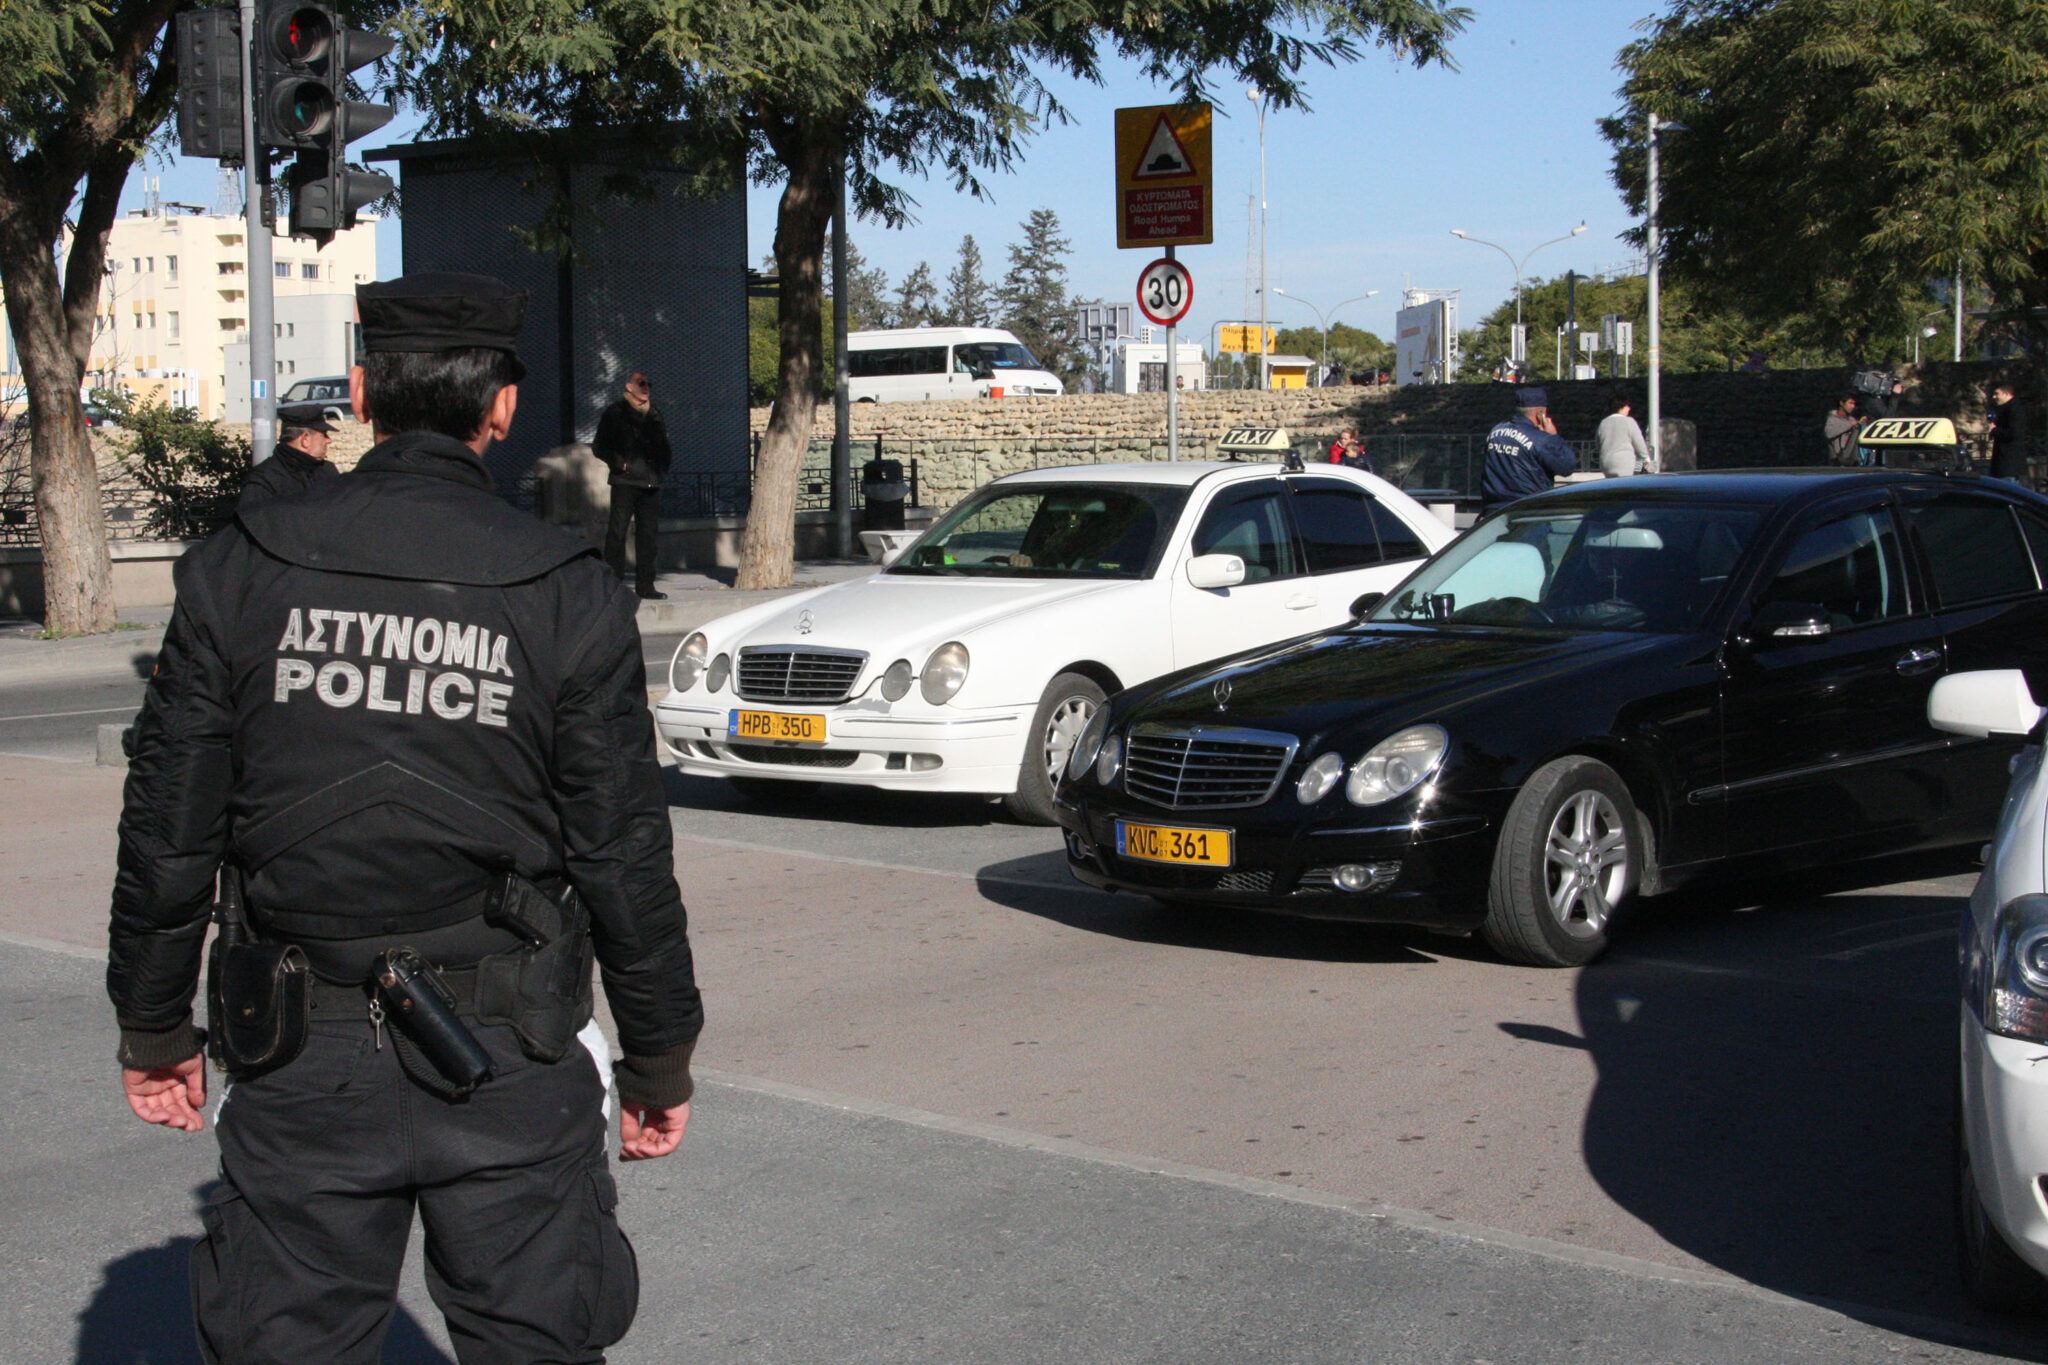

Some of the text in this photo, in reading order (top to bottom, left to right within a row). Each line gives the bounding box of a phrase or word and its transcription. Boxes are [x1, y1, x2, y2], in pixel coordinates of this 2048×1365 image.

[1134, 215, 1192, 225] Road Humps
[1148, 225, 1177, 235] Ahead
[1148, 274, 1182, 310] 30
[1226, 430, 1274, 444] TAXI
[1870, 421, 1934, 438] TAXI
[277, 608, 514, 677] ΑΣΤΥΝΟΜΙΑ
[273, 658, 514, 727] POLICE
[742, 714, 771, 734] HPB
[781, 716, 812, 737] 350
[1128, 826, 1211, 860] KVC 361
